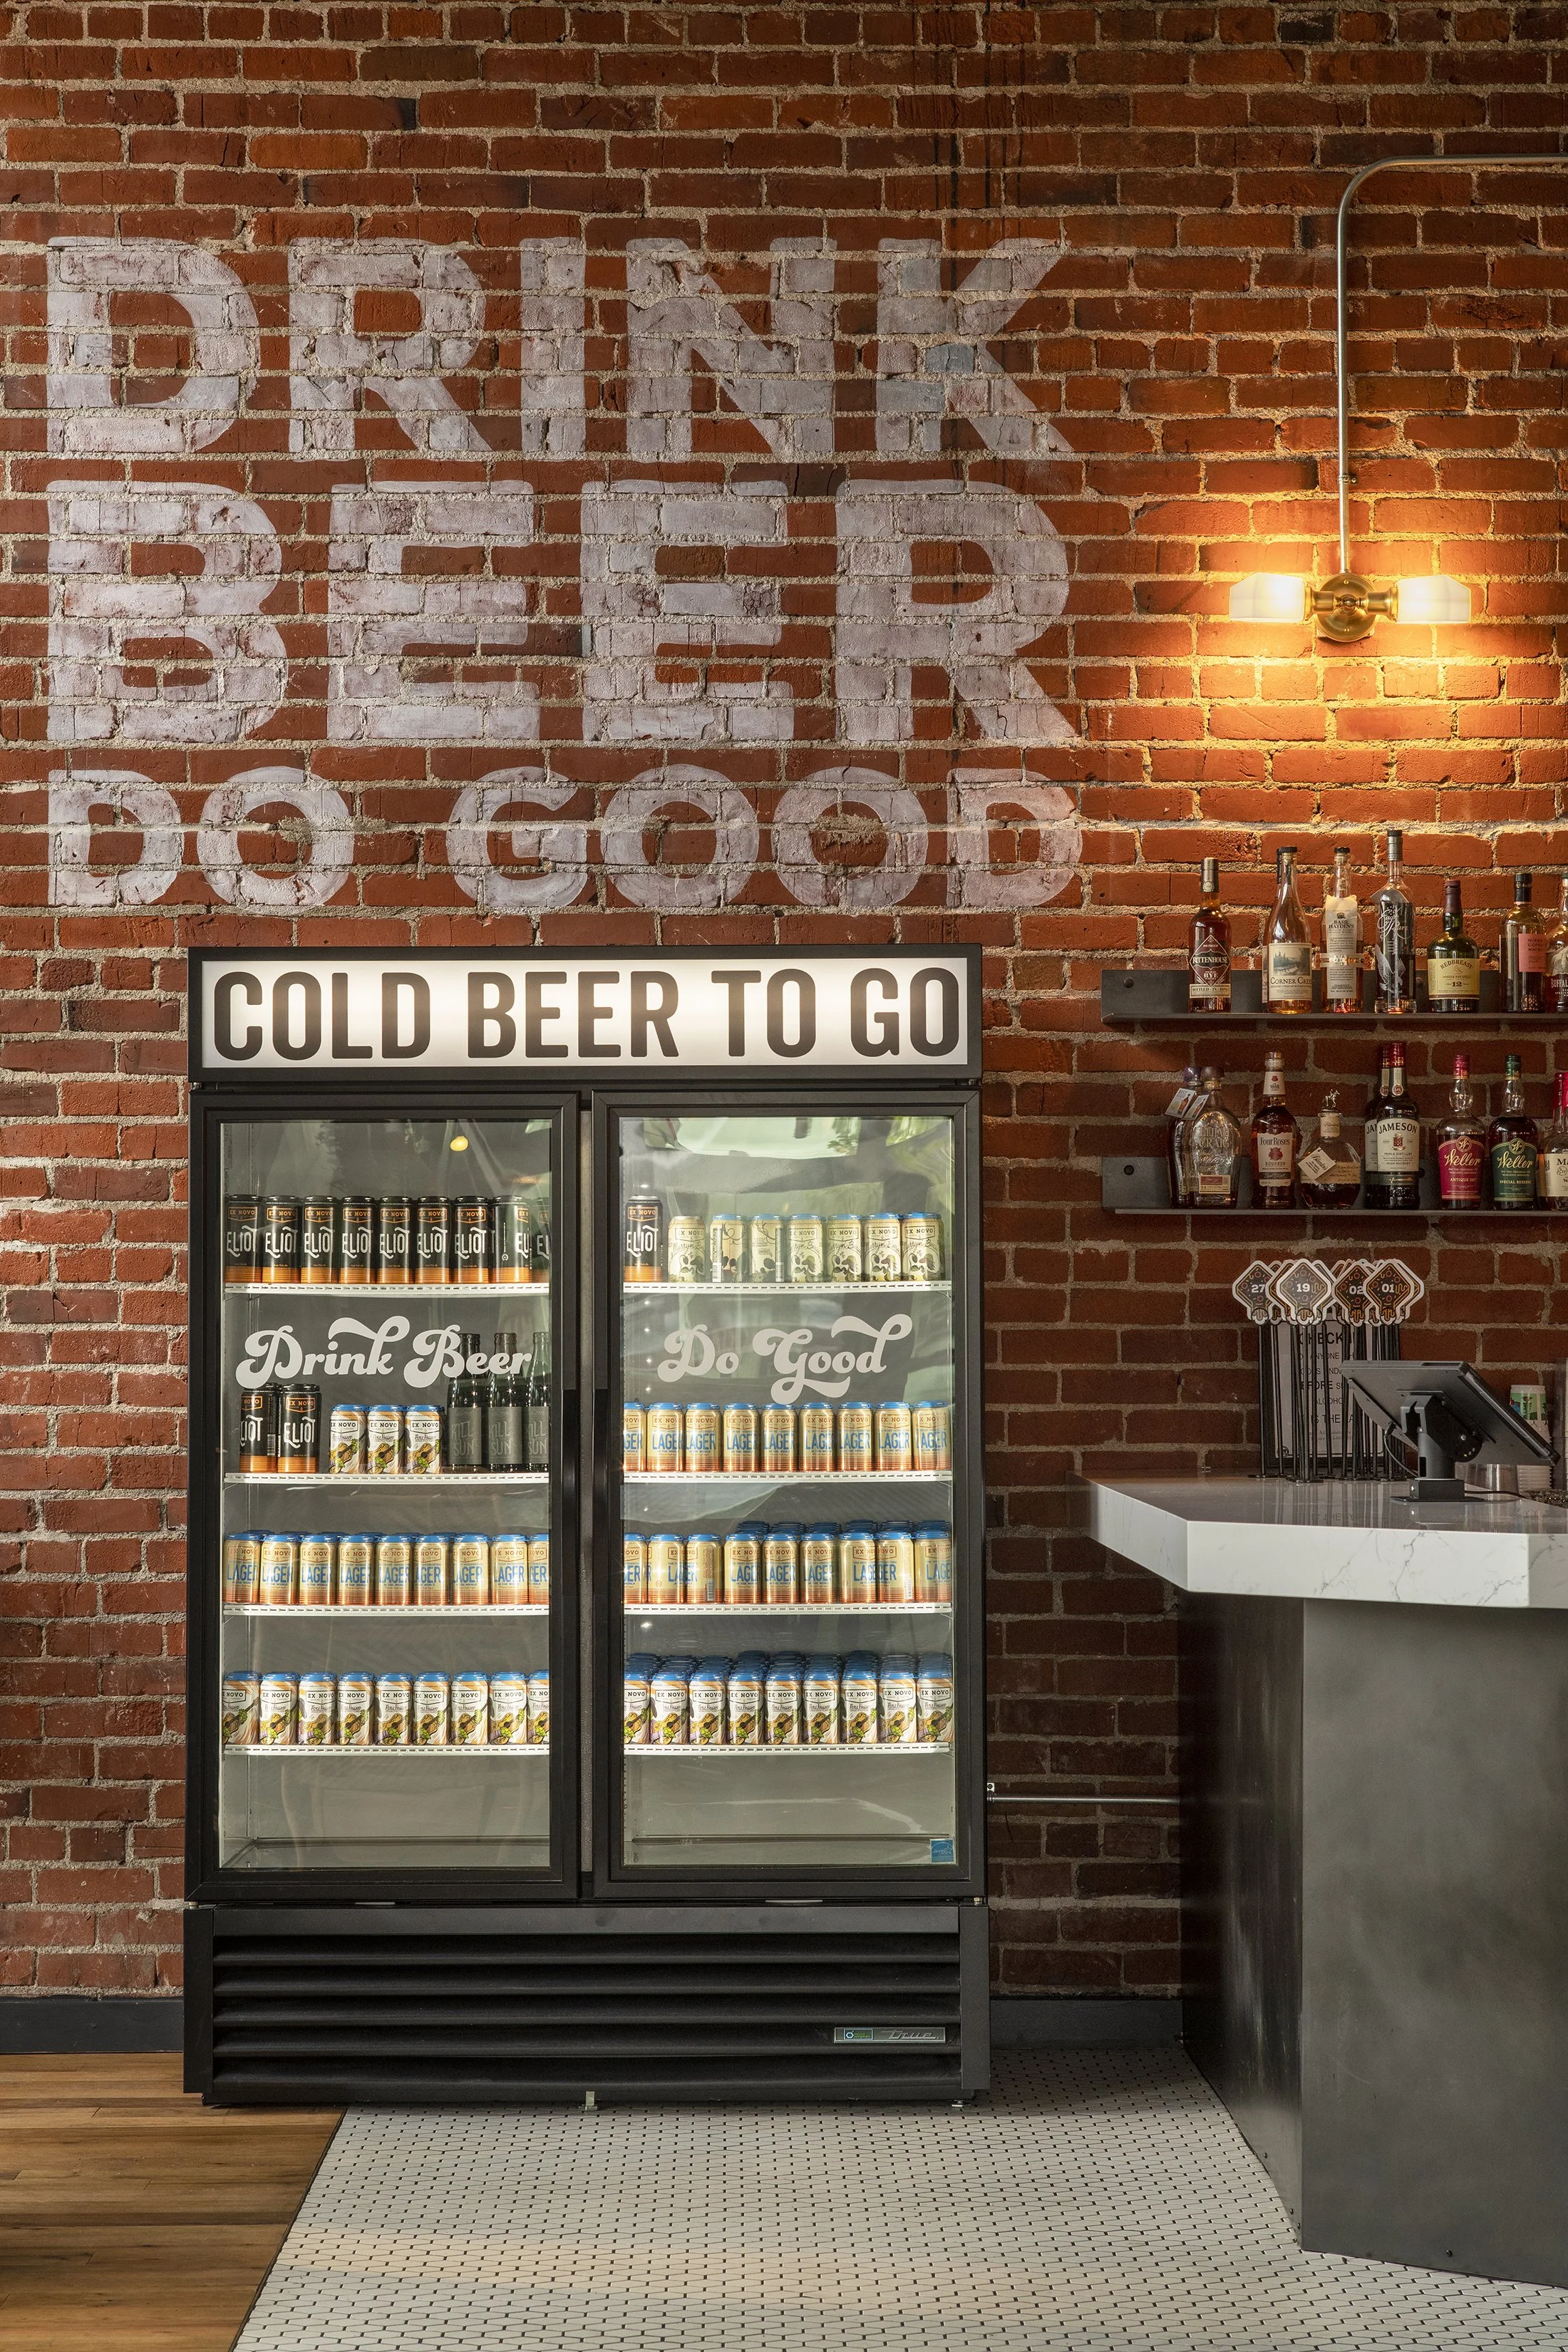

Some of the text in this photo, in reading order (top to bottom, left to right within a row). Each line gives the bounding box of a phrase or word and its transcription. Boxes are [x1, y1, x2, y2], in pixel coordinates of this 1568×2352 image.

[46, 237, 1074, 462] DRINK
[46, 479, 1076, 742] BEER
[48, 764, 1084, 909] DO GOOD
[1440, 959, 1472, 969] REDBREAST
[214, 967, 960, 1061] COLD BEER TO GO
[1378, 1123, 1418, 1134] JAMESON
[1444, 1149, 1481, 1166] Weller
[1497, 1151, 1534, 1168] Weller
[227, 1225, 257, 1257] ELIOT
[265, 1227, 298, 1259] ELIOT
[304, 1227, 335, 1259] ELIOT
[342, 1227, 373, 1259] ELIOT
[379, 1227, 410, 1259] ELIOT
[417, 1227, 448, 1259] ELIOT
[455, 1227, 486, 1259] ELIOT
[626, 1224, 659, 1257] ELIOT
[1251, 1284, 1266, 1294] 27
[1296, 1284, 1310, 1292] 19
[1349, 1285, 1364, 1294] 02
[1382, 1284, 1395, 1293] 01
[235, 1315, 532, 1389] Drink Beer
[657, 1314, 913, 1405] Do Good
[240, 1414, 263, 1447] LIOT
[284, 1416, 316, 1449] ELIOT
[491, 1438, 512, 1455] SUN
[839, 1432, 870, 1449] LAGER
[879, 1432, 909, 1449] LAGER
